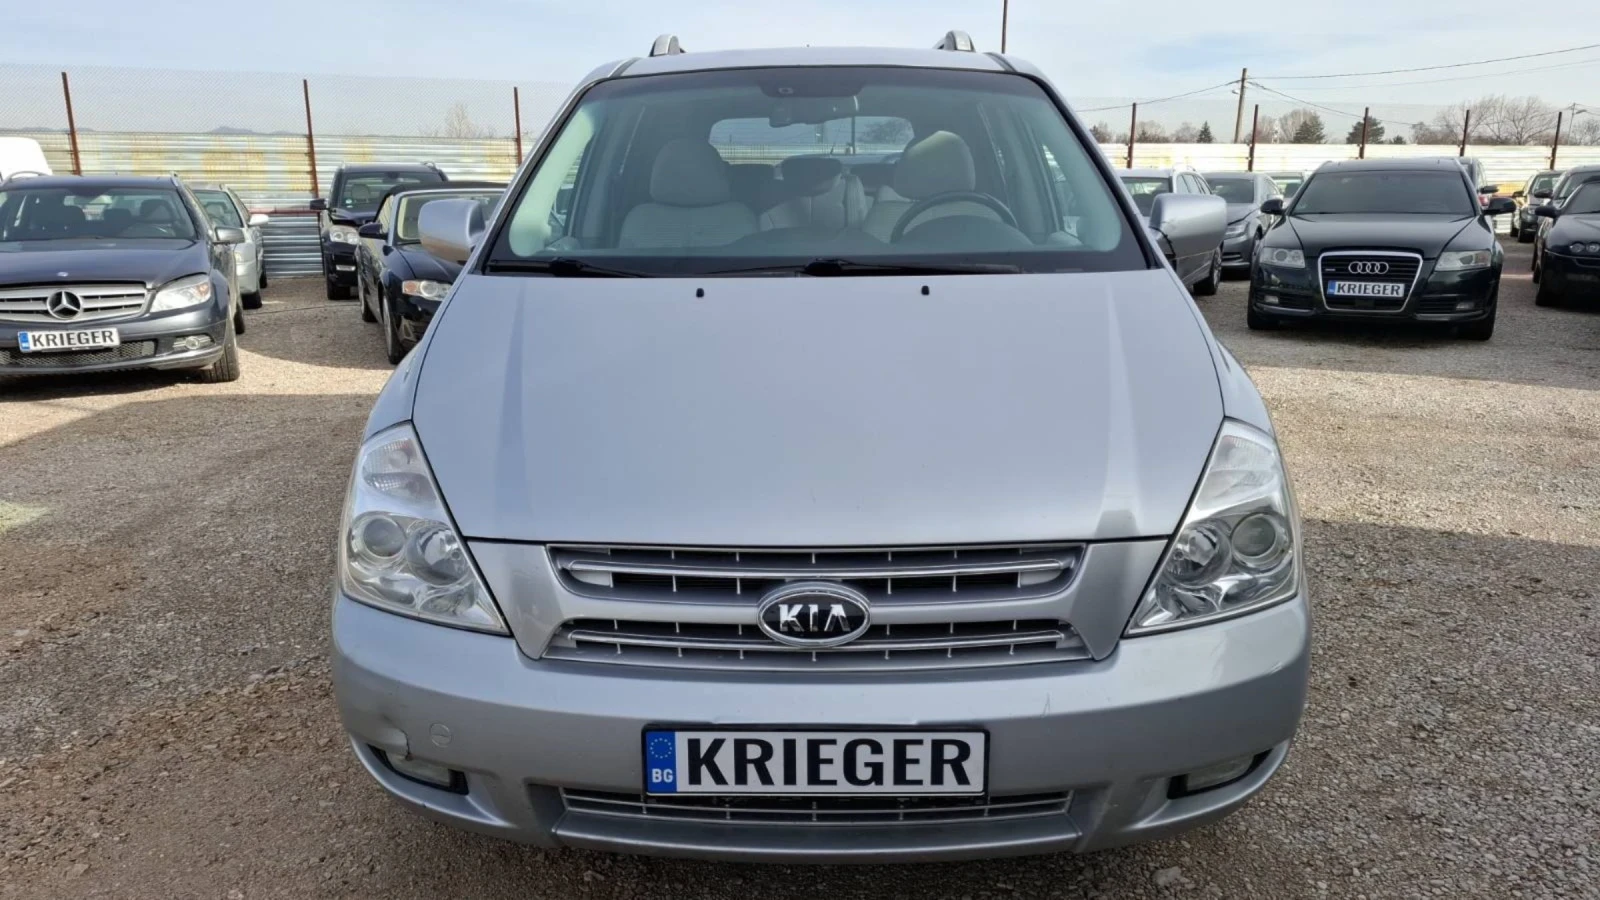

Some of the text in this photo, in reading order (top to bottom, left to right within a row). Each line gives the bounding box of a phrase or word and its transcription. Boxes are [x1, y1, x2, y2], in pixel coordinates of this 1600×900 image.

[1336, 283, 1401, 296] KRIEGER
[31, 330, 115, 348] KRIEGER
[778, 603, 852, 632] KIA
[687, 738, 972, 786] KRIEGER
[651, 768, 674, 783] BG
